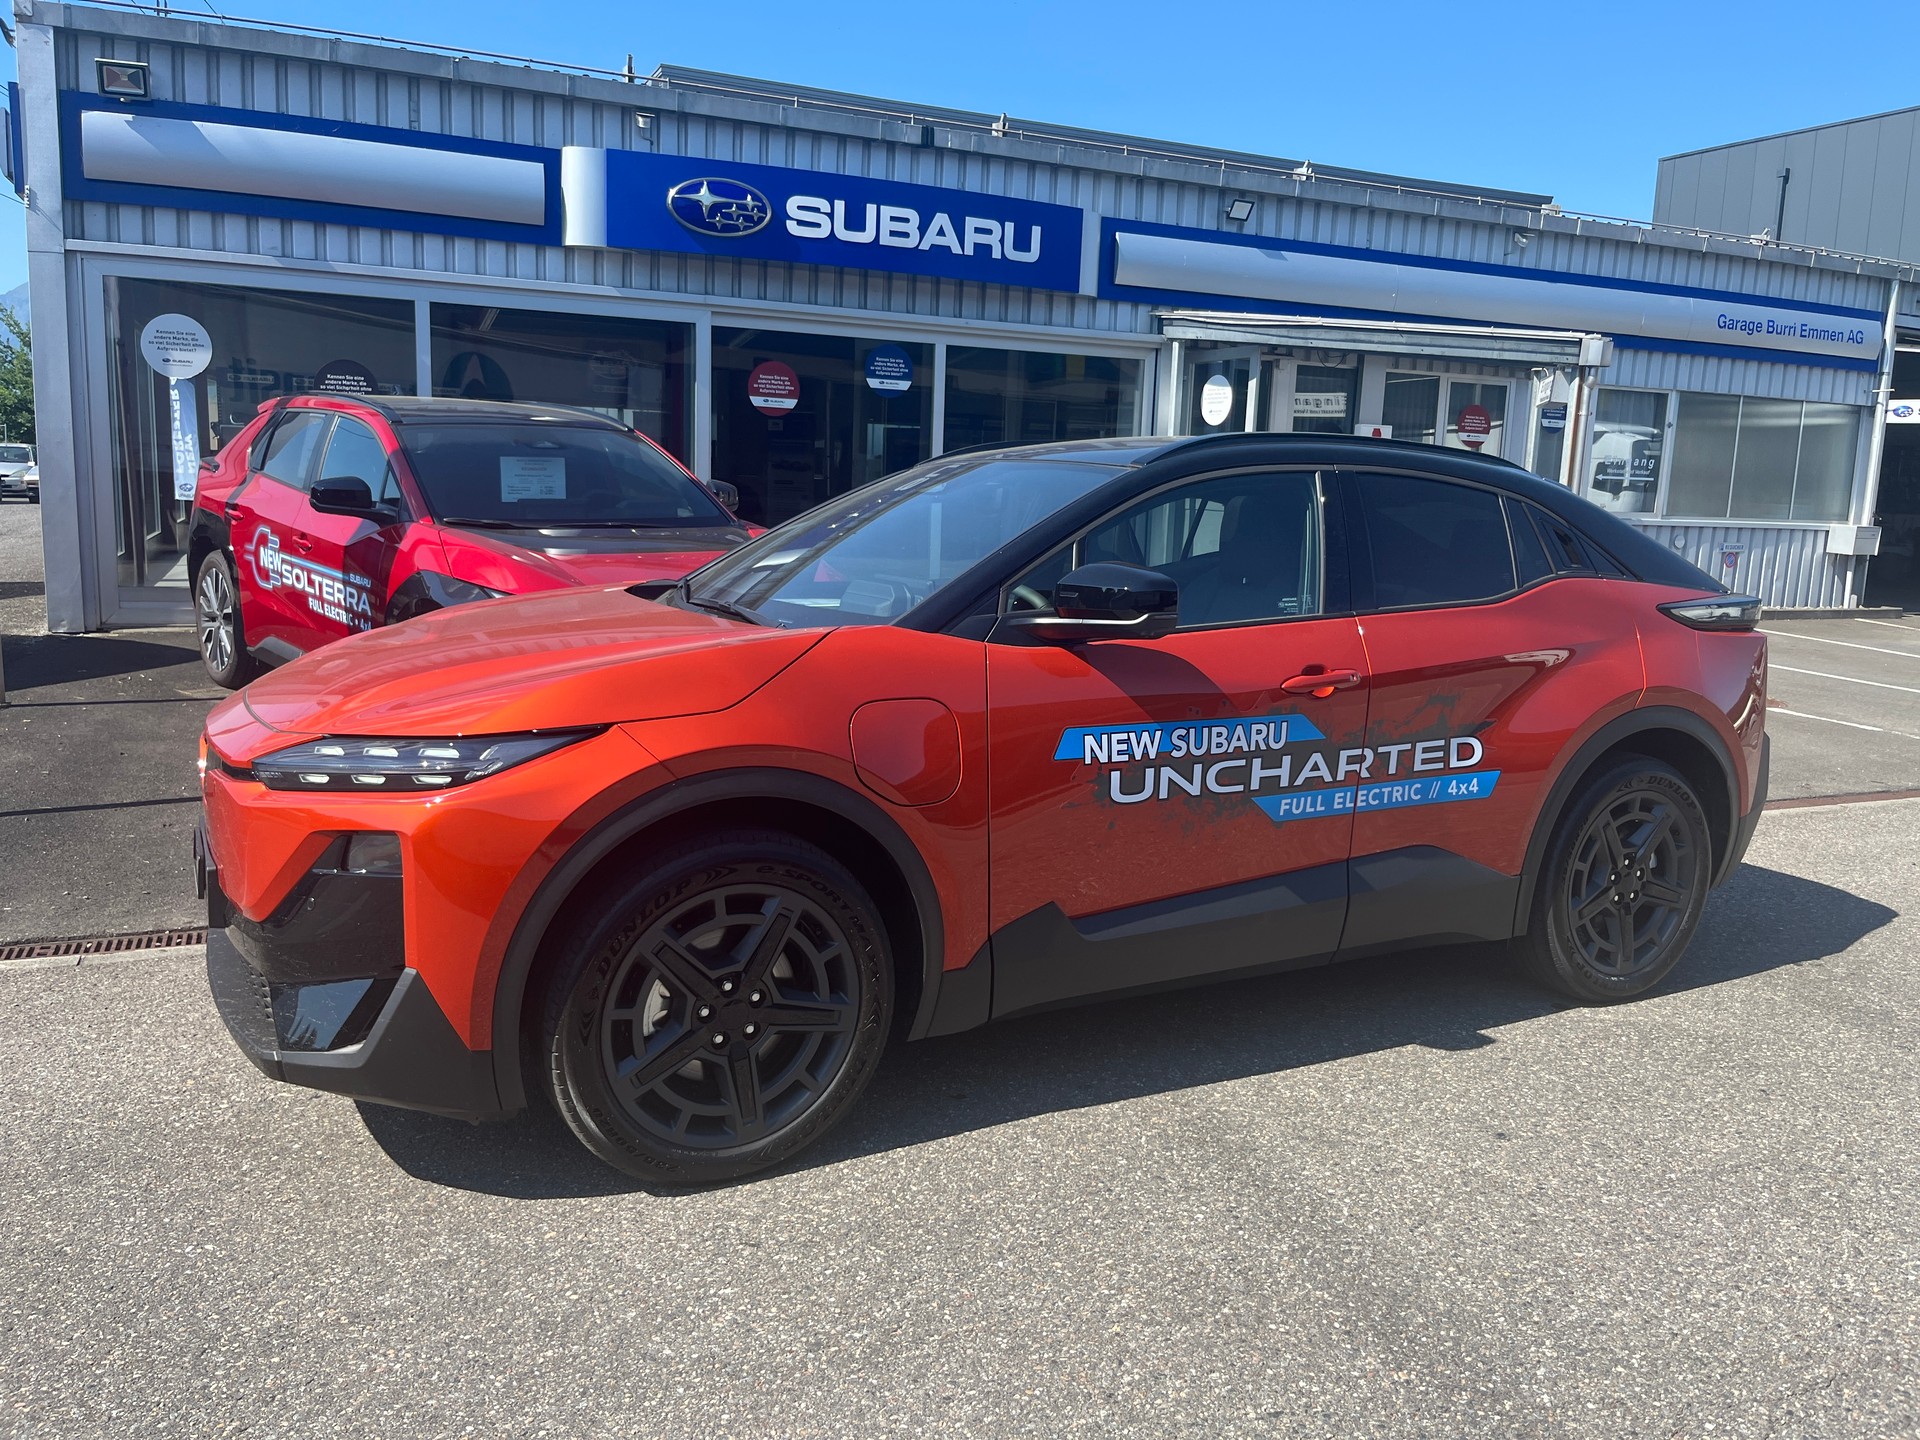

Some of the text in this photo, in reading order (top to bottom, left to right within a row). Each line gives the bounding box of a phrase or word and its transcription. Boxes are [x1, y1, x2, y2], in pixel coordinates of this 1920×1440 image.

[785, 195, 1041, 263] SUBARU
[1717, 314, 1864, 345] Garage Burri Emmen AG
[260, 546, 281, 572] NEW
[282, 563, 372, 616] SOLTERRA
[350, 574, 372, 588] SUBARU
[308, 597, 324, 614] FULL
[324, 603, 354, 626] ELECTRIC
[1083, 721, 1289, 765] NEW SUBARU
[1109, 735, 1485, 804] UNCHARTED
[1278, 795, 1326, 817] FULL
[1333, 783, 1422, 810] ELECTRIC
[1447, 777, 1480, 796] 4x4
[1646, 776, 1697, 810] DUNLOP
[598, 879, 693, 979] DUNLOP
